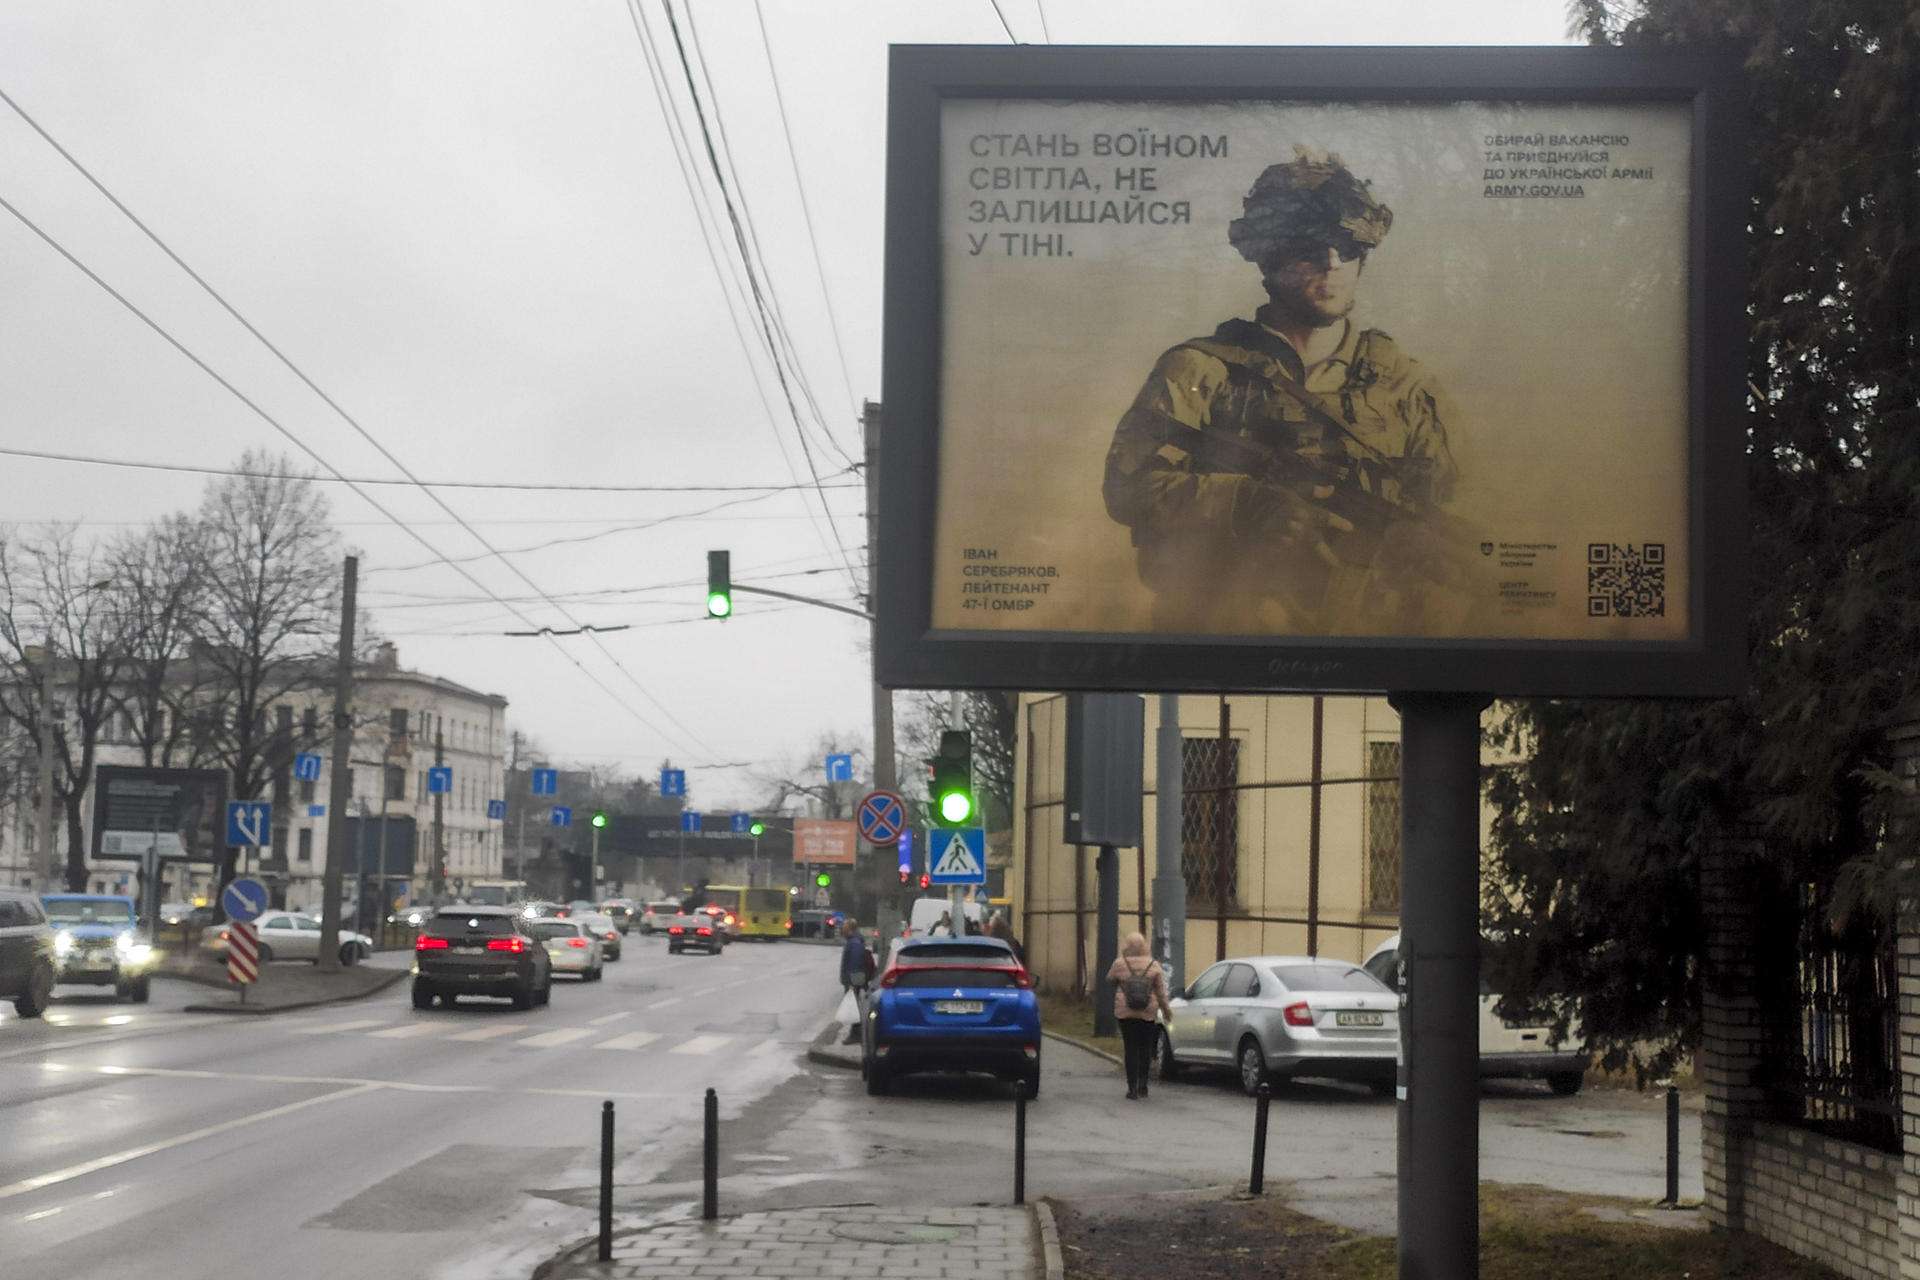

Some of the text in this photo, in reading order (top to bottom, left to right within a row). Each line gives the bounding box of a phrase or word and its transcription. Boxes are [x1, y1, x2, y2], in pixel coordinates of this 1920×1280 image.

[968, 128, 1229, 159] СТАНЬ ВОЇНОМ
[1484, 132, 1630, 147] ОБИРАЙ ВАКАНСІЮ
[1485, 151, 1609, 164] ТА ПРИЄДНУЙСЯ
[968, 167, 1157, 194] СВІТЛА, НЕ
[1483, 166, 1654, 181] ДО УКРАЇНСЬКОЇ АРМІЇ
[1484, 184, 1584, 198] ARMY.GOV.UA
[968, 194, 1191, 225] ЗАЛИШАЙСЯ
[968, 233, 1074, 257] У ТІНІ.
[963, 548, 997, 560] ІВАН
[962, 565, 1060, 579] СЕРЕБРЯКОВ,
[962, 580, 1050, 594] ЛЕЙТЕНАНТ
